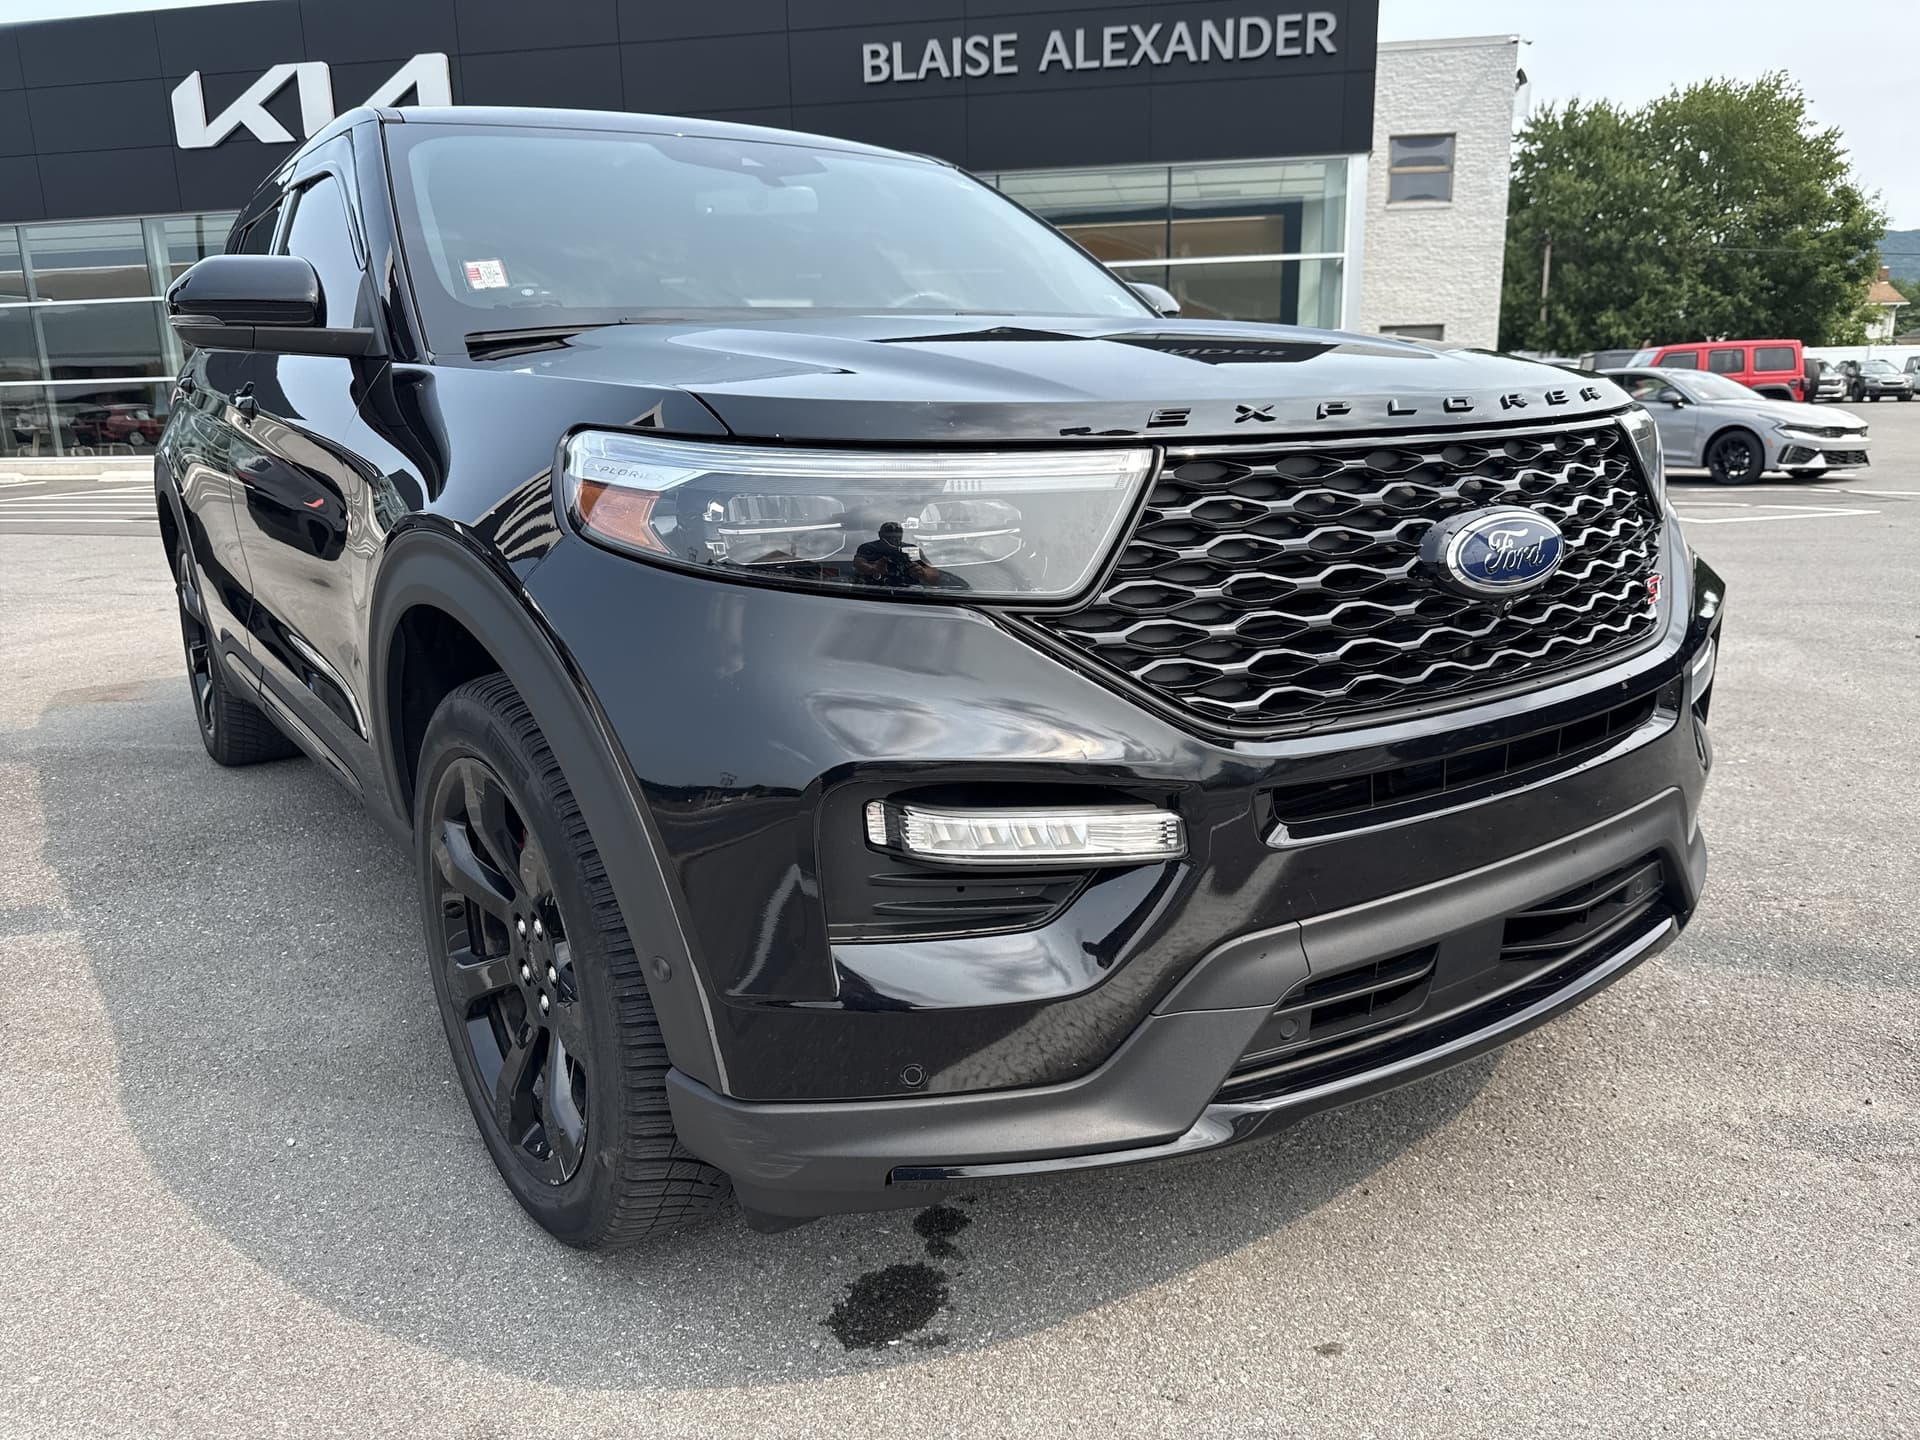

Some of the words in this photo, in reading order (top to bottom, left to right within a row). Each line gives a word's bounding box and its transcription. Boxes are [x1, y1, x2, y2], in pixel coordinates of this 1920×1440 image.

[862, 33, 1018, 83] BLAISE
[1038, 12, 1337, 71] ALEXANDER
[171, 53, 453, 149] KIA
[1147, 386, 1603, 429] EXPLORER
[1484, 527, 1545, 574] Ford
